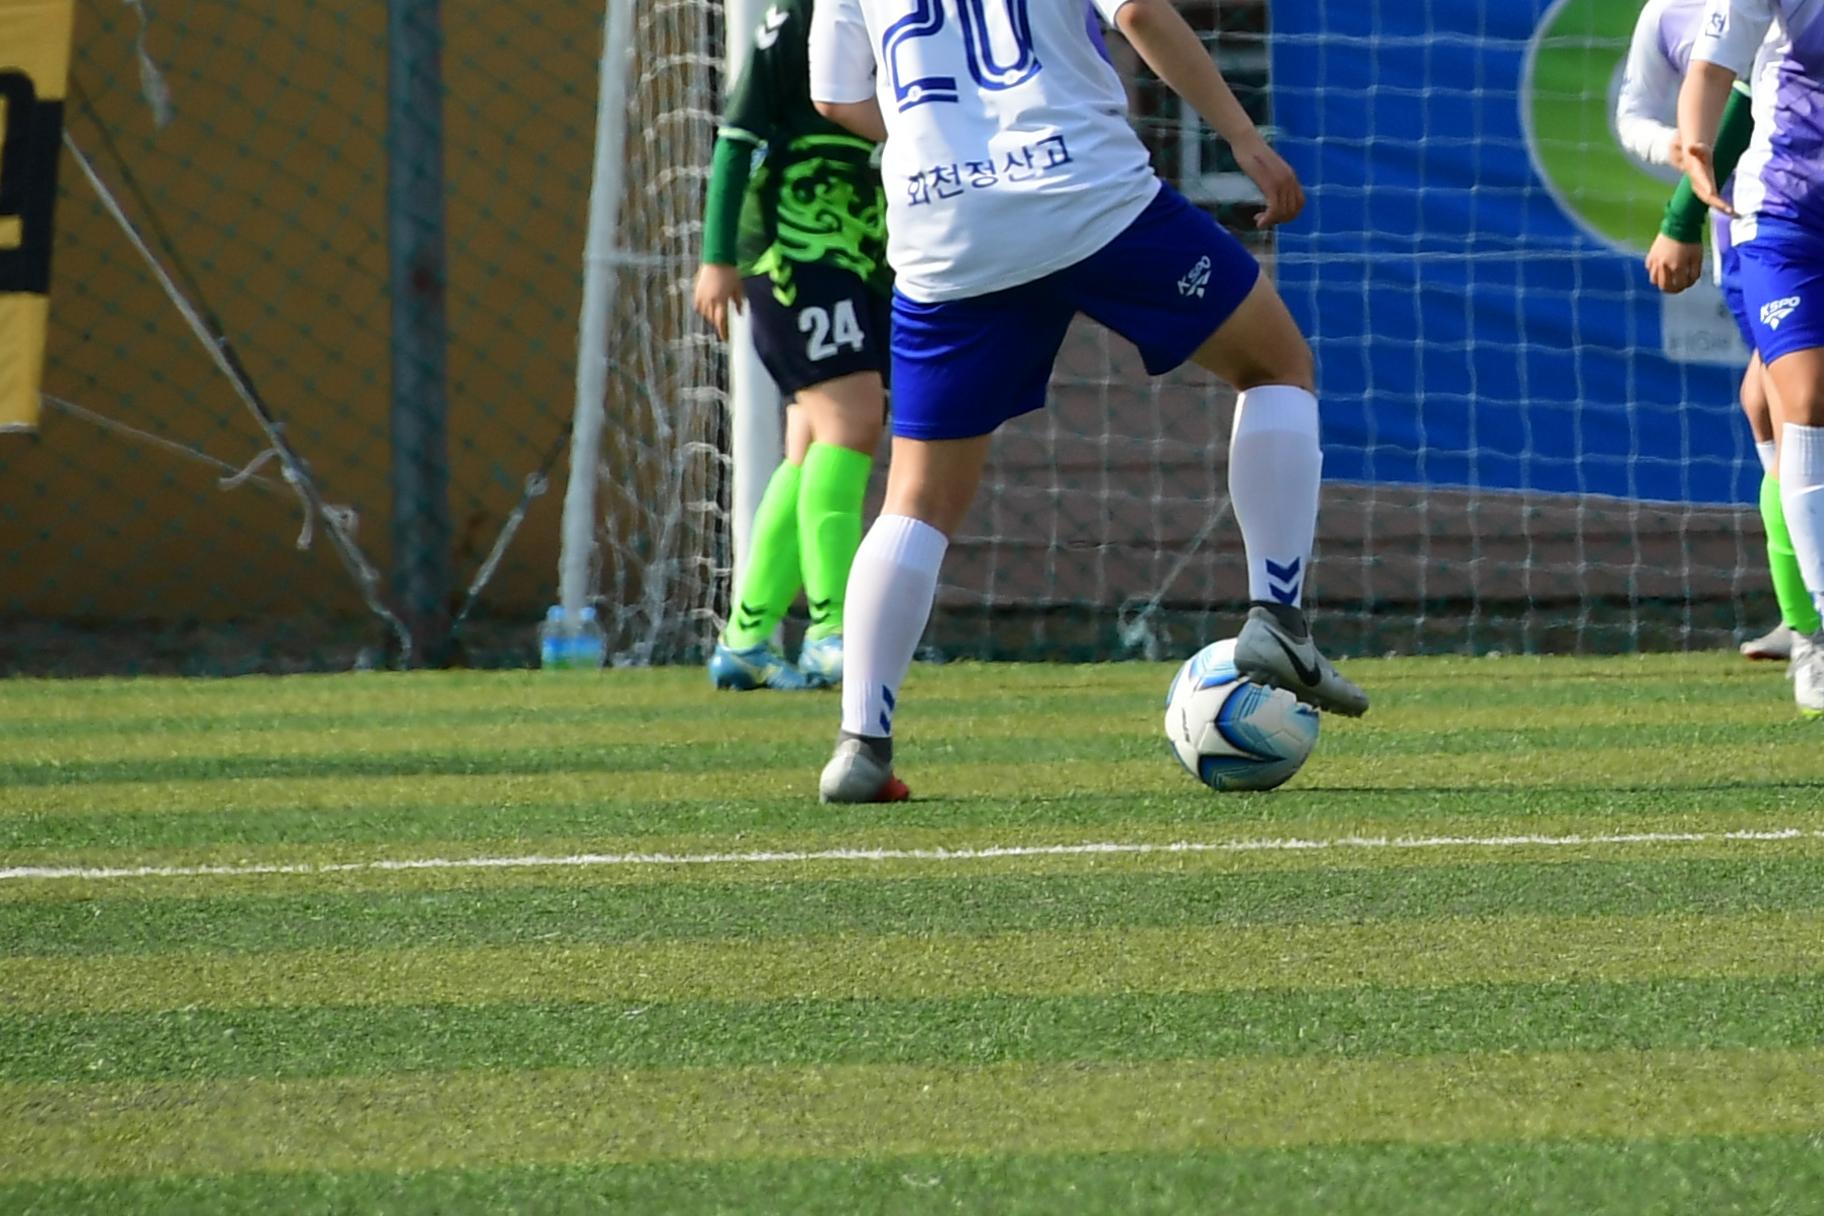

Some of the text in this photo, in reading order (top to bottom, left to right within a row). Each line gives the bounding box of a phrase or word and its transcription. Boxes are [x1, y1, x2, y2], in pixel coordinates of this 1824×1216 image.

[907, 134, 1074, 207] 화천정산고
[798, 299, 866, 362] 24
[1760, 295, 1801, 323] KSPO
